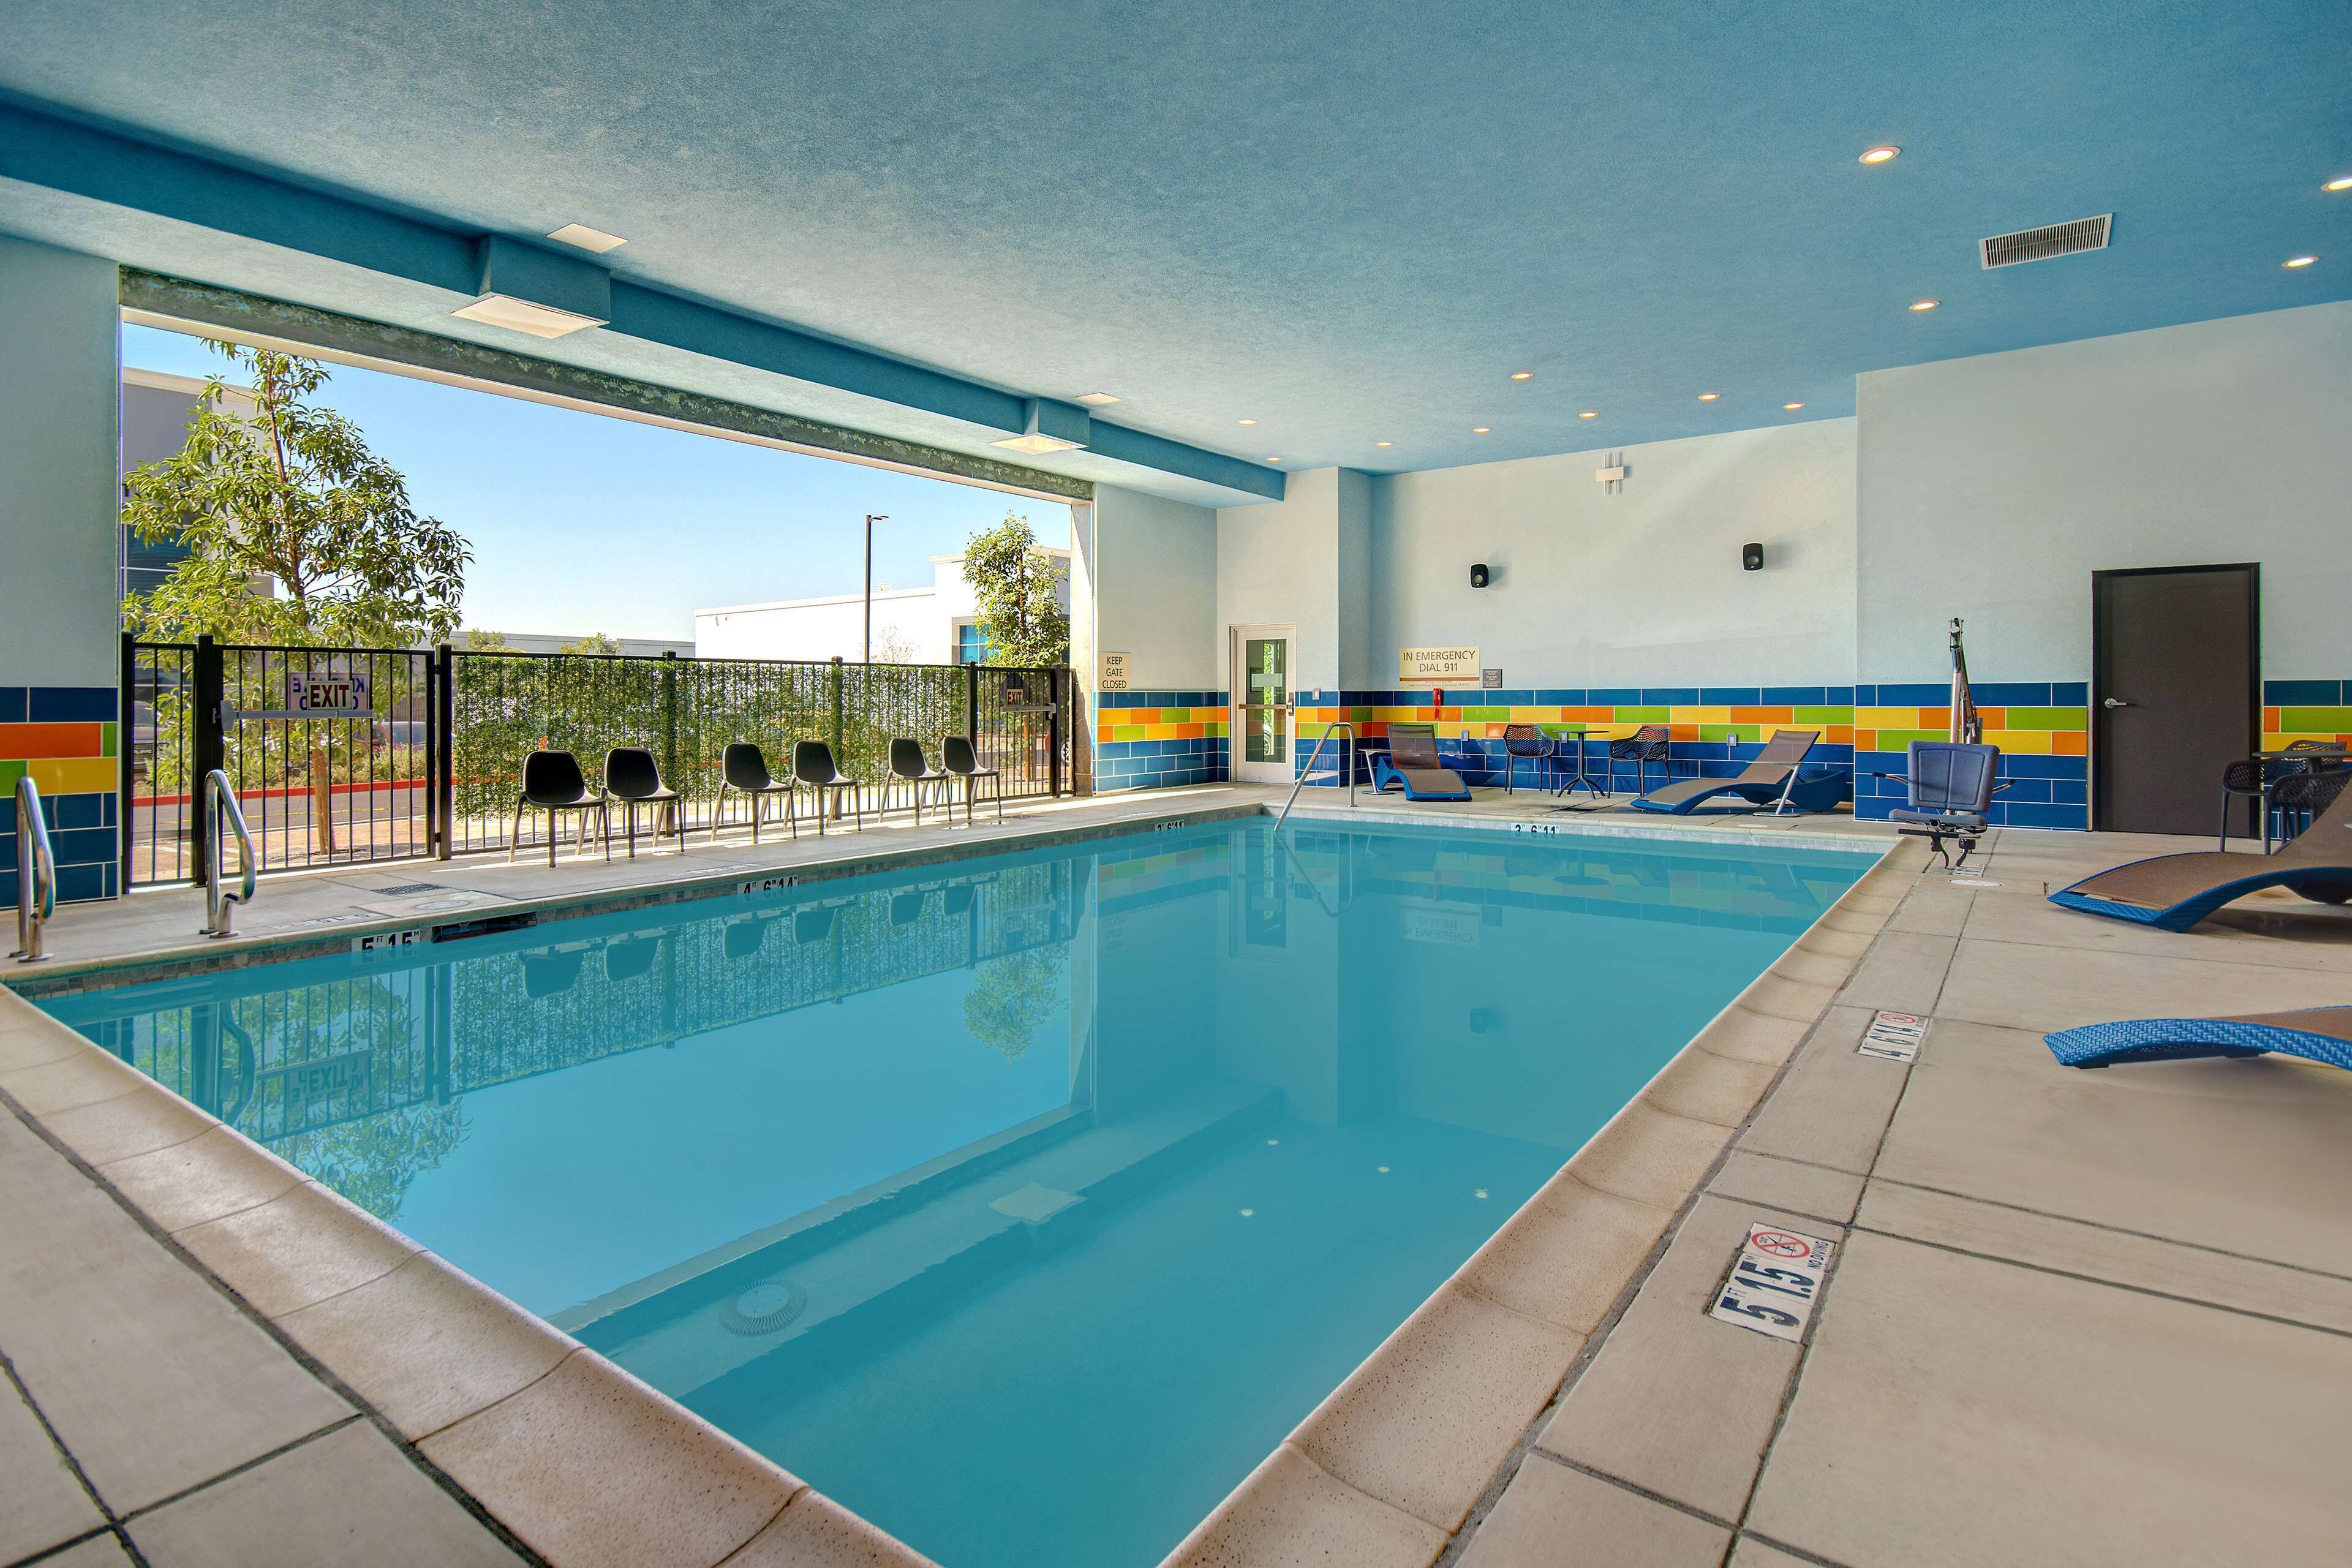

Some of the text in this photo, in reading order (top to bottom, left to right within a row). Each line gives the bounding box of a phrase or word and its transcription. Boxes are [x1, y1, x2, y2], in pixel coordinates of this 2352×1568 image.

[1107, 656, 1123, 665] KEEP
[1403, 650, 1476, 661] IN EMERGENCY
[1106, 668, 1123, 677] GATE
[1419, 663, 1458, 672] DIAL 911
[1102, 680, 1127, 688] CLOSED
[311, 685, 349, 707] EXIT
[1008, 692, 1022, 705] EXIT
[1807, 1240, 1829, 1270] NO DIVING
[1720, 1296, 1800, 1327] 5
